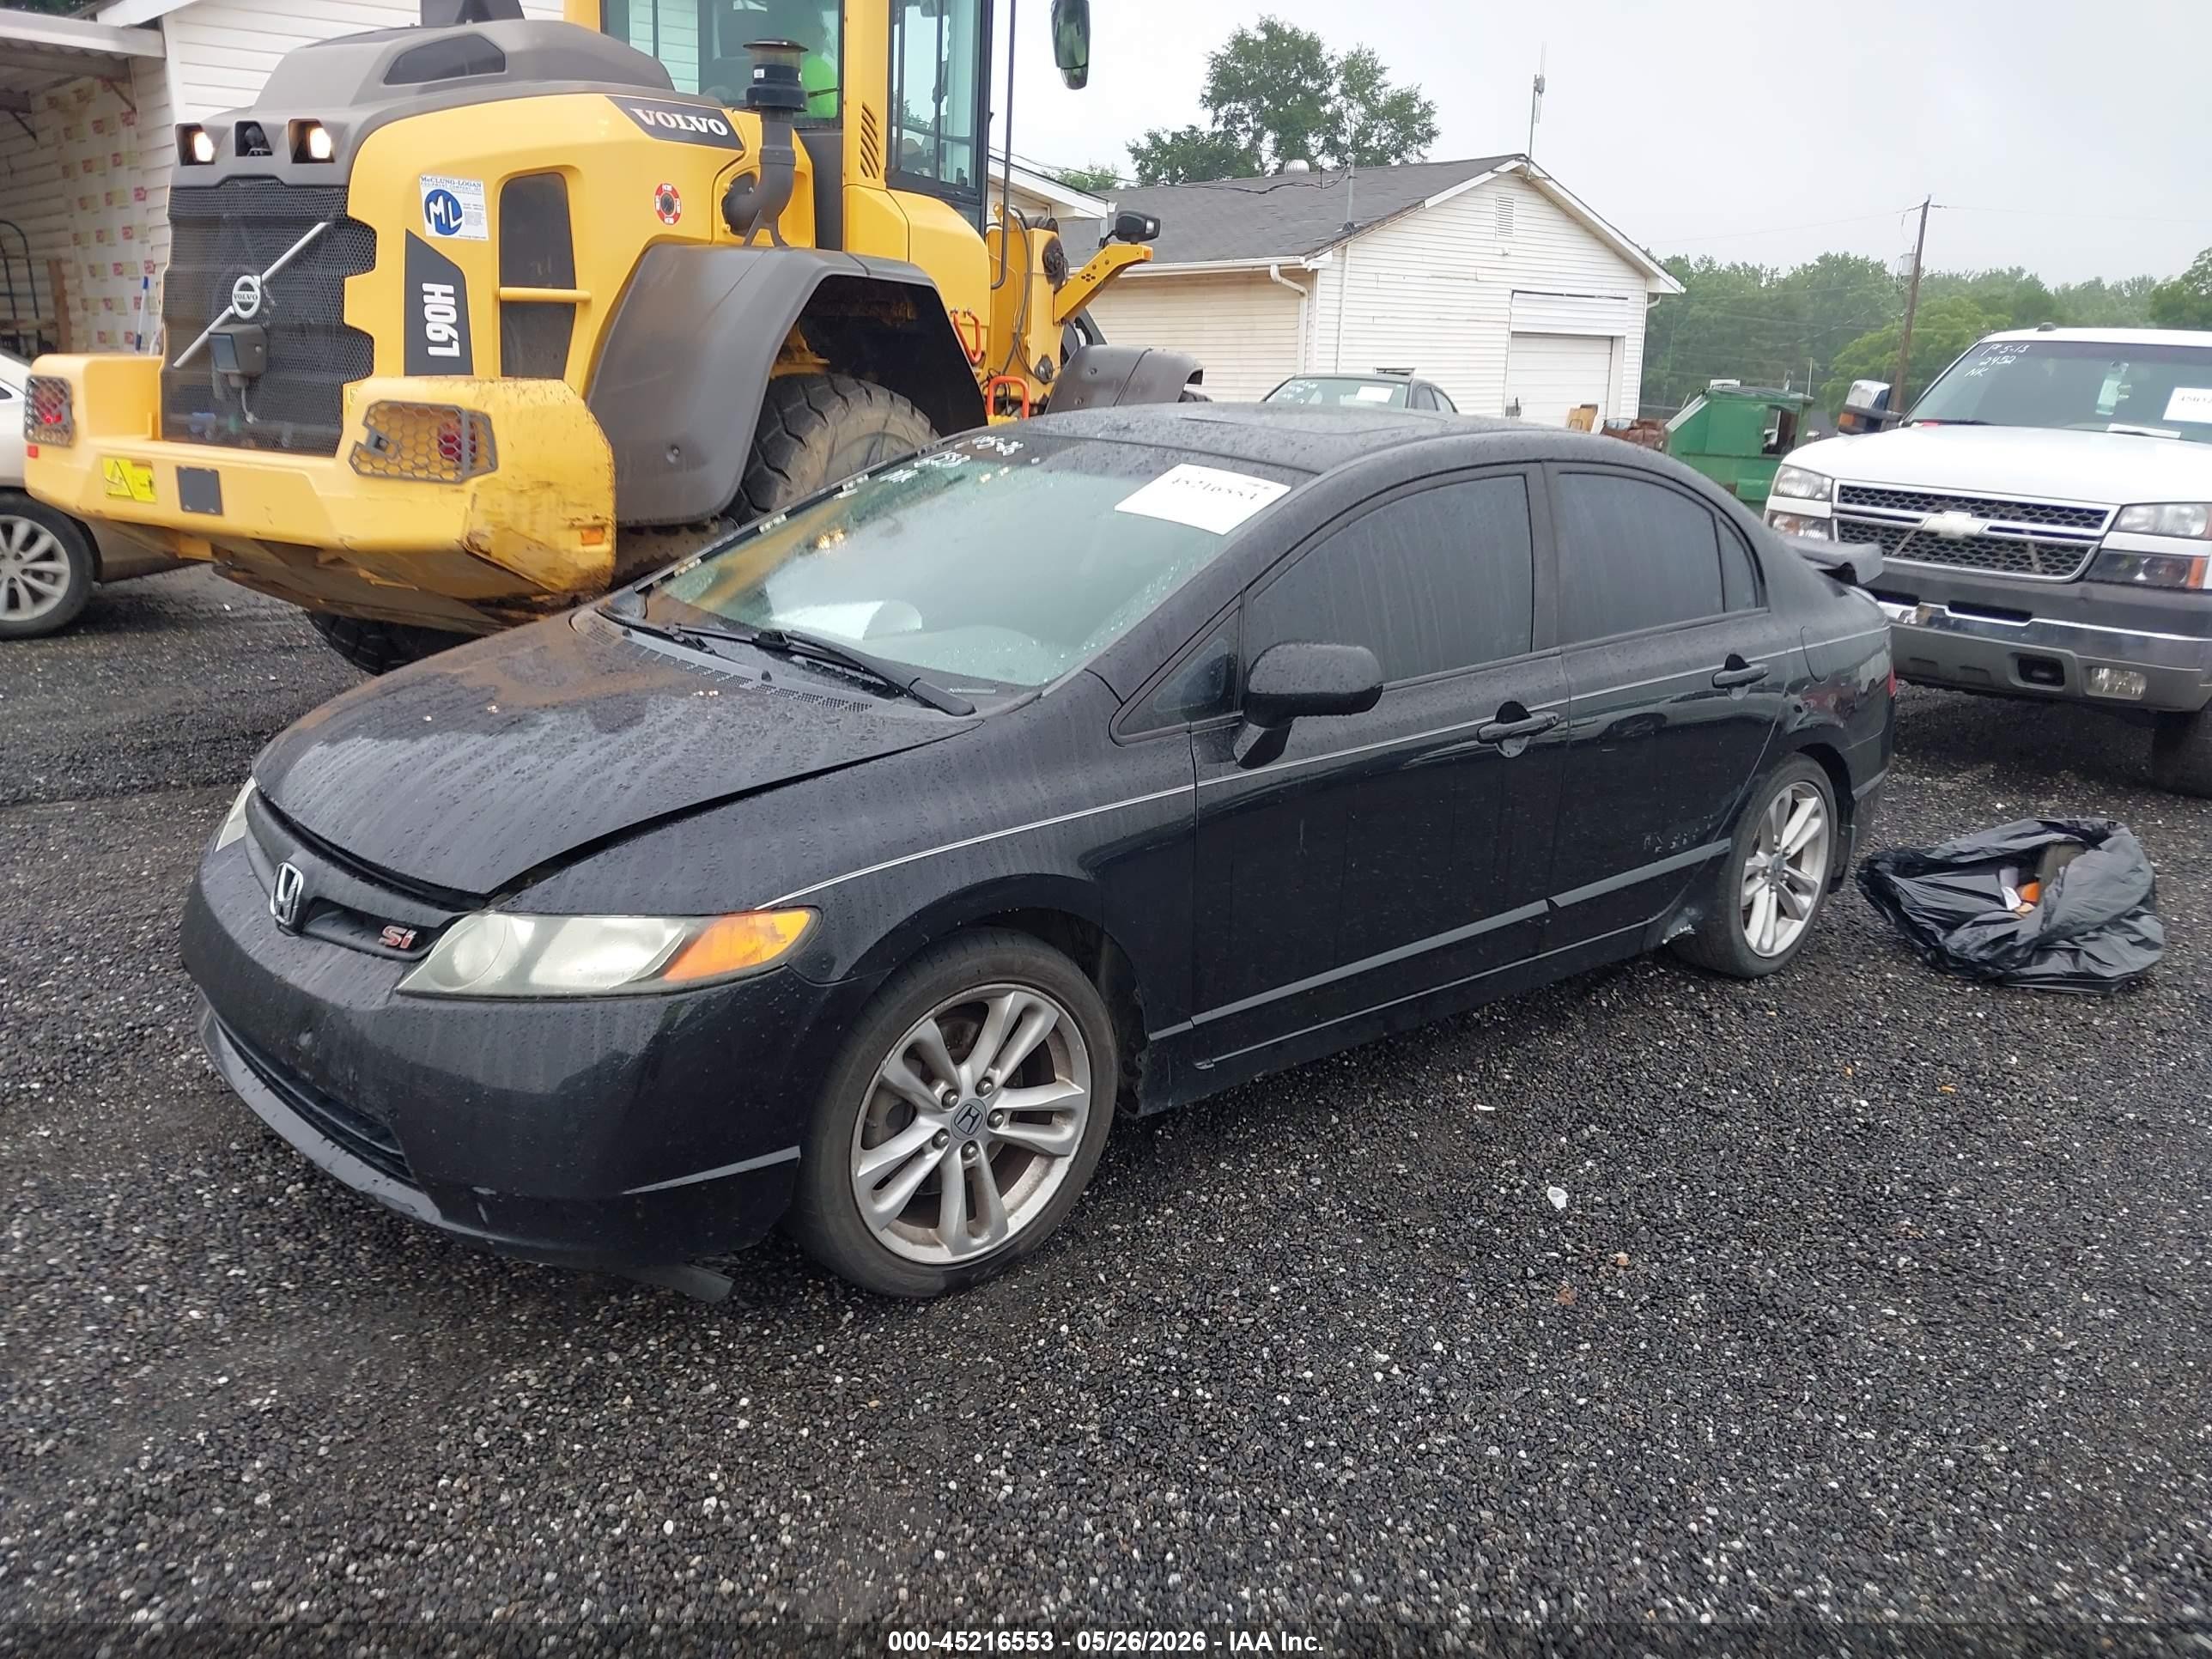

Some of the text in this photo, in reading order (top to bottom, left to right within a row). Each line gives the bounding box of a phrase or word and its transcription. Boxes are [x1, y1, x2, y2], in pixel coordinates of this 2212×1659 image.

[630, 107, 728, 136] VOLVO
[428, 194, 463, 234] ML
[422, 283, 460, 357] L90H
[378, 925, 417, 949] Si
